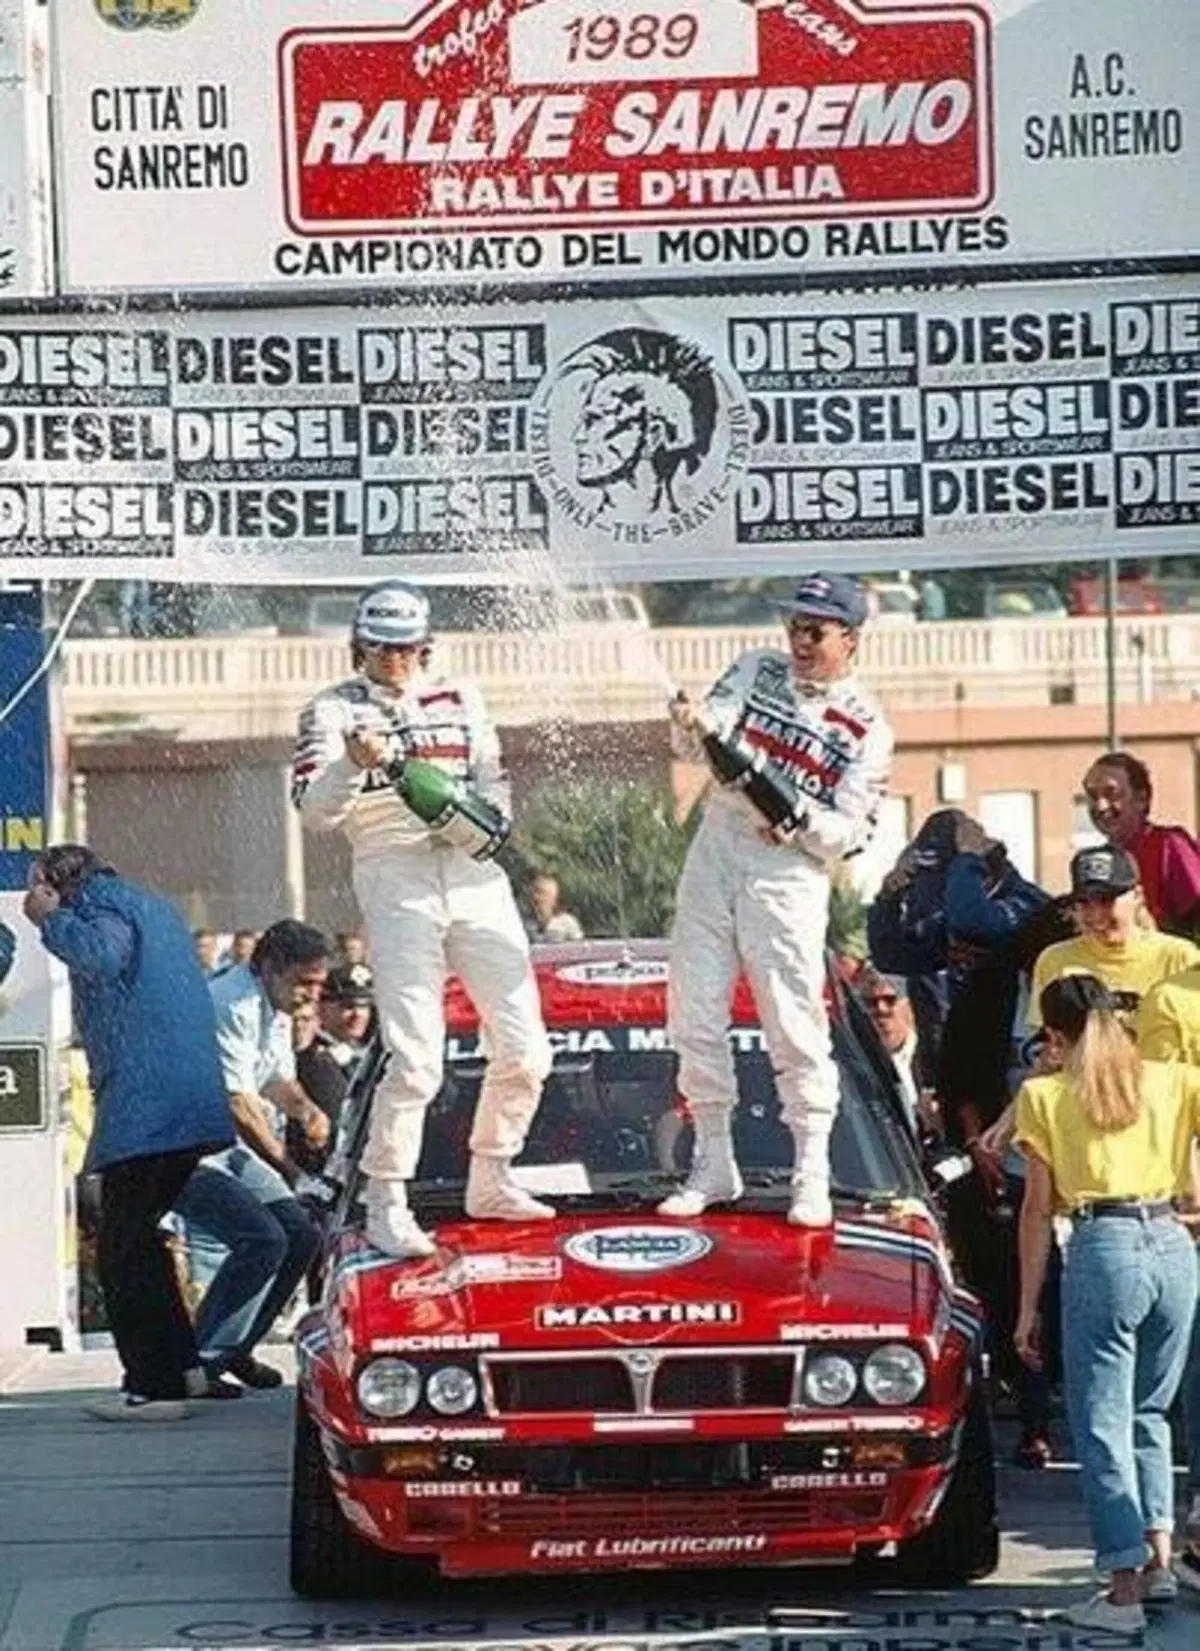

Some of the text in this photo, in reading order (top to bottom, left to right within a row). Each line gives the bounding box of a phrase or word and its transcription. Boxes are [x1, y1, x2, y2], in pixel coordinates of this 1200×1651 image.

[563, 15, 699, 62] 1989
[1070, 53, 1136, 98] A.C.
[199, 85, 228, 130] DI
[303, 79, 971, 165] RALLYE SANREMO
[1025, 109, 1183, 160] SANREMO
[95, 143, 248, 191] SANREMO
[429, 165, 845, 211] RALLYE D'ITALIA
[274, 216, 1010, 276] CAMPIONATO DEL MONDO RALLYES
[733, 317, 916, 373] DIESEL
[926, 311, 1106, 366] DIESEL
[1115, 303, 1200, 355] DIE
[0, 335, 169, 387] DIESEL
[176, 335, 355, 387] DIESEL
[363, 330, 543, 384] DIESEL
[925, 384, 1109, 442] DIESEL
[1119, 380, 1200, 430] DIE
[0, 411, 167, 463] DIESEL
[177, 408, 358, 462] DIESEL
[739, 468, 920, 523] DIESEL
[929, 462, 1109, 516] DIESEL
[1120, 453, 1200, 506] DIE
[0, 486, 173, 539] DIESEL
[183, 488, 358, 538] DIESEL
[366, 480, 546, 536] DIESEL
[612, 522, 653, 544] THE
[542, 1302, 738, 1327] MARTINI
